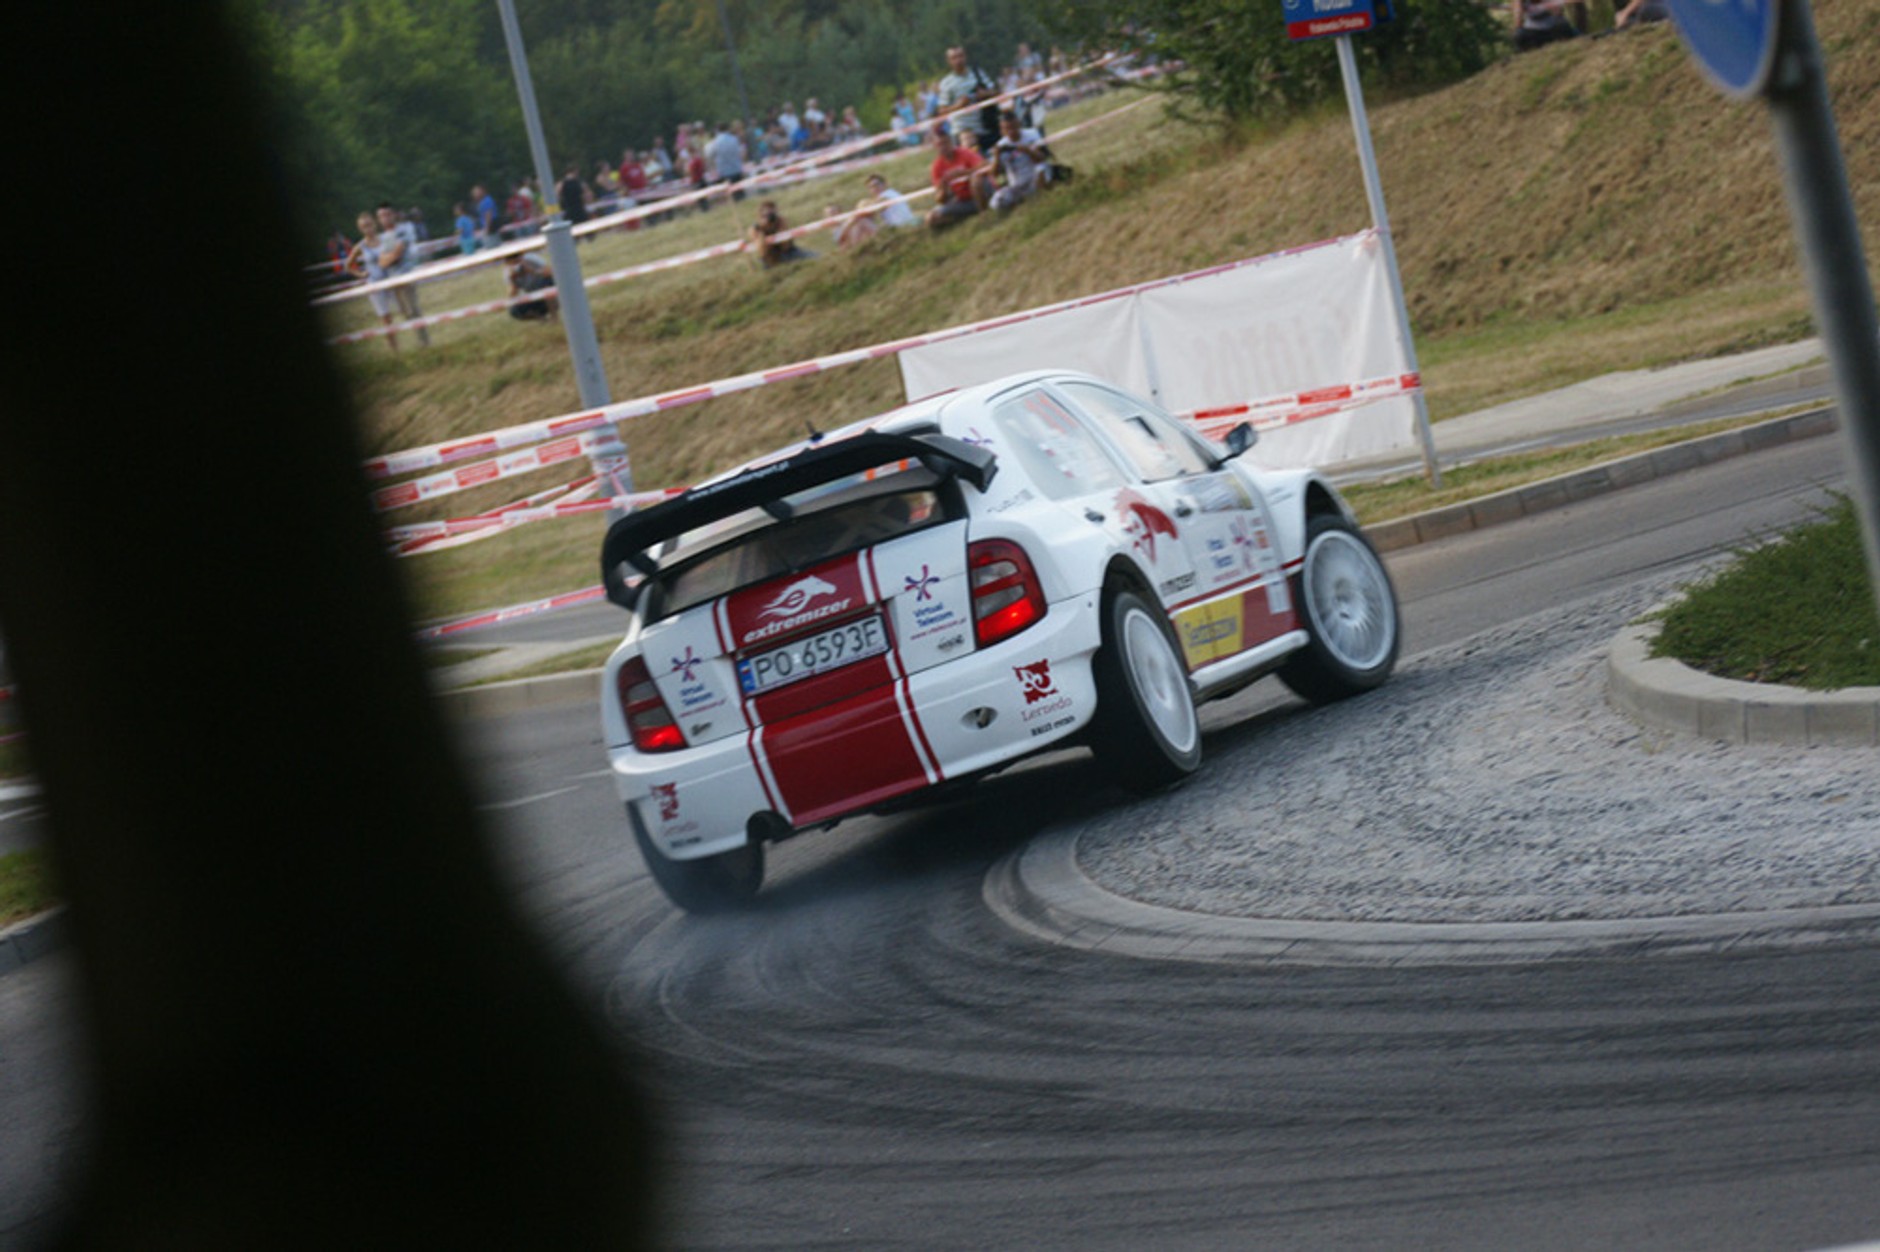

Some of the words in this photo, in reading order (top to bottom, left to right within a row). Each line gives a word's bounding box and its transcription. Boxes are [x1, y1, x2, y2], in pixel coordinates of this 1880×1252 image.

[743, 598, 851, 643] extremizer
[754, 651, 793, 686] PO
[802, 618, 878, 668] 6593F
